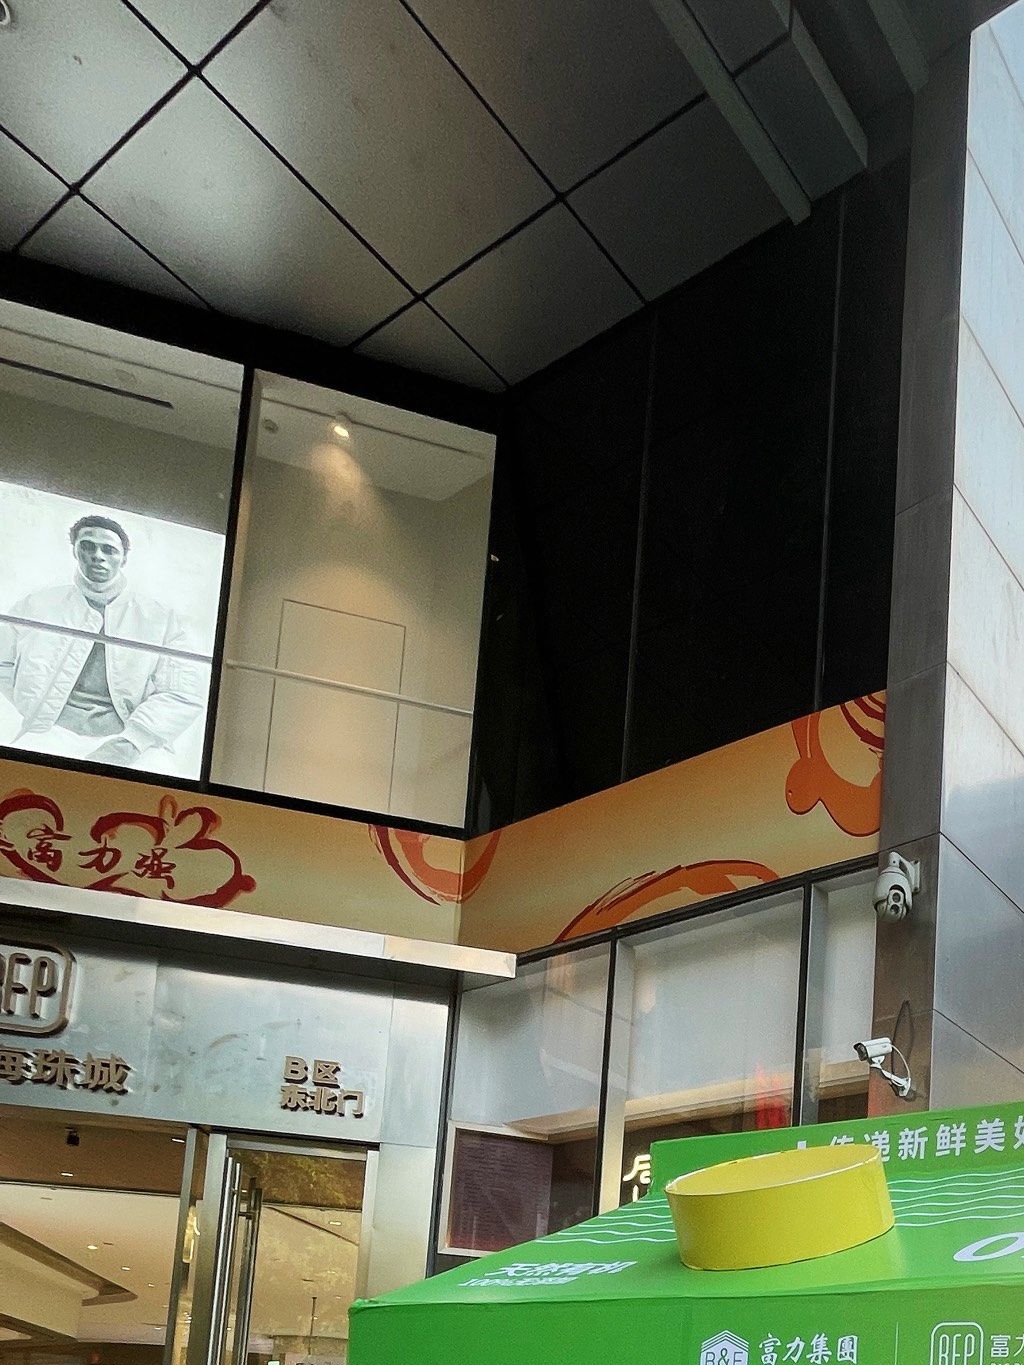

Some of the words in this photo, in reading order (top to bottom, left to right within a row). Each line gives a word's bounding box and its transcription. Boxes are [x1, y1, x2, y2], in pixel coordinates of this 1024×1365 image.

[0, 952, 59, 1018] FP
[283, 1055, 341, 1088] B区
[280, 1084, 364, 1118] 东北门
[759, 1332, 859, 1365] 富力集團
